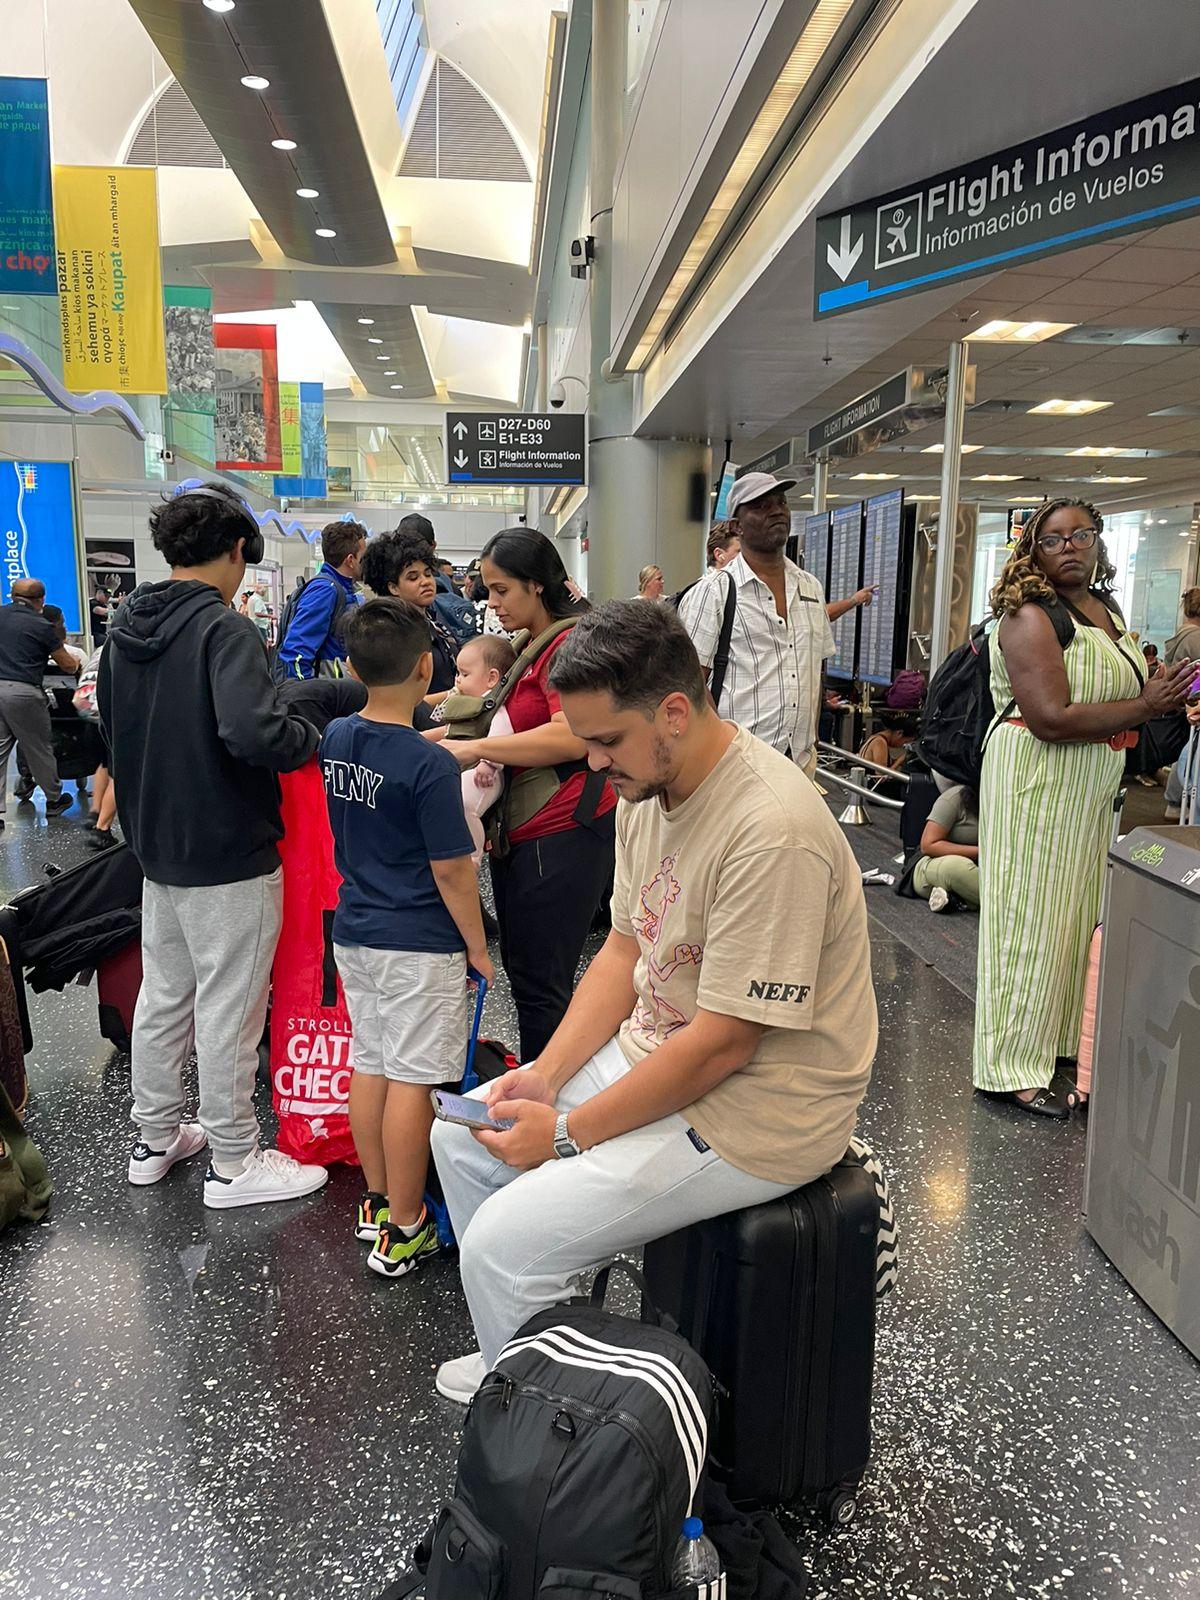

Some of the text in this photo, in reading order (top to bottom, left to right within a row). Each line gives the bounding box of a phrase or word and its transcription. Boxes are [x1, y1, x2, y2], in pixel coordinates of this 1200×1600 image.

[927, 103, 1200, 222] Flight Informa
[112, 222, 119, 235] an
[925, 163, 1164, 254] Información de Vuelos
[57, 250, 71, 363] marknadsplats pazar
[71, 250, 82, 313] kios makanan
[81, 250, 99, 363] sehemu ya sokini
[110, 251, 127, 311] Kaupat
[498, 418, 551, 430] D27-D60
[499, 433, 543, 445] E1-E33
[824, 395, 880, 438] FLIGHT INFORMATION
[499, 450, 581, 461] Flight Information
[499, 461, 534, 469] Información
[4, 530, 23, 594] tplace
[323, 758, 384, 810] FDNY
[747, 979, 811, 1004] NEFF
